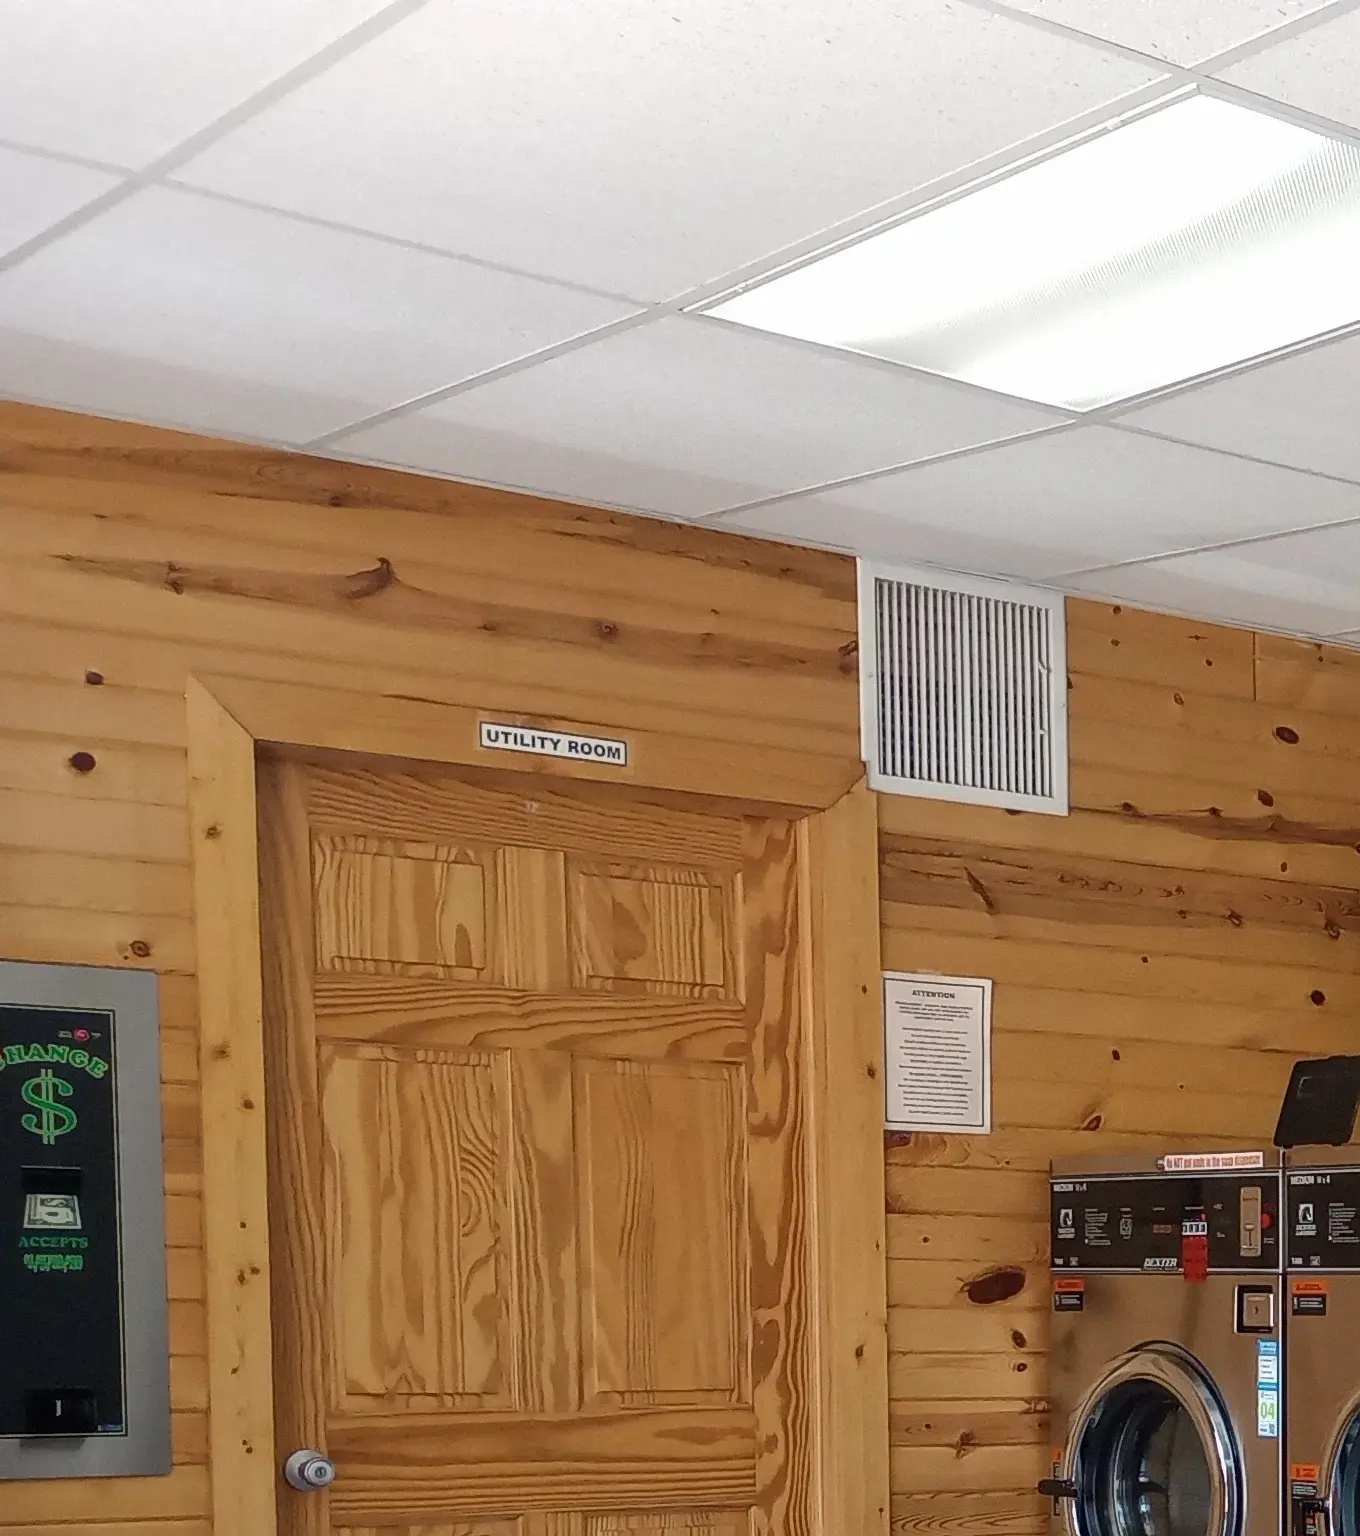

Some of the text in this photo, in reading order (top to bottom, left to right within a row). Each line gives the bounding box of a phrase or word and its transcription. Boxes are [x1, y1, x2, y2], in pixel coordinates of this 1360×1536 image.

[486, 729, 621, 760] UTILITY ROOM
[0, 1043, 108, 1079] HANGE
[18, 1236, 89, 1249] ACCEPTS
[1144, 1257, 1178, 1270] DEXTER
[1260, 1401, 1275, 1419] 04
